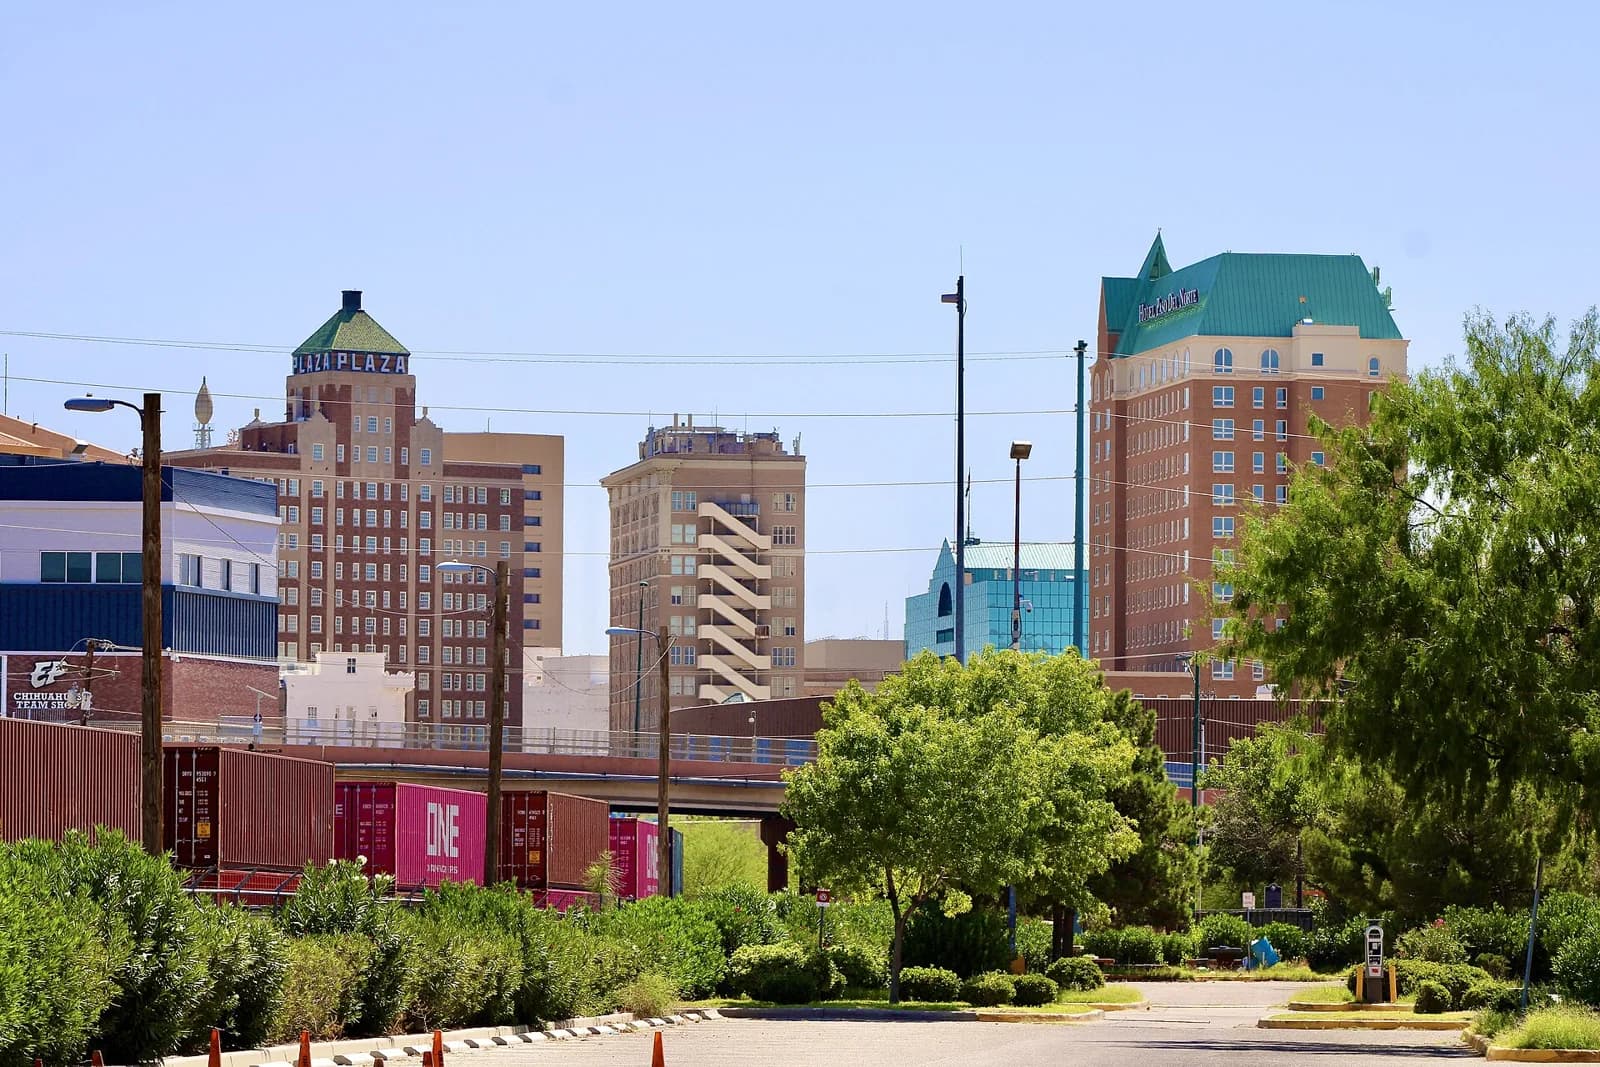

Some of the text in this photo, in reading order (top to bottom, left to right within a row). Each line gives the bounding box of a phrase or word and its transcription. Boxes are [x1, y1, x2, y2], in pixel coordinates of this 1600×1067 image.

[292, 352, 330, 374] PLAZA
[337, 352, 406, 373] PLAZA
[13, 692, 82, 701] CHIHUAHUS
[16, 701, 78, 710] TEAM SHO
[426, 801, 460, 858] ONE
